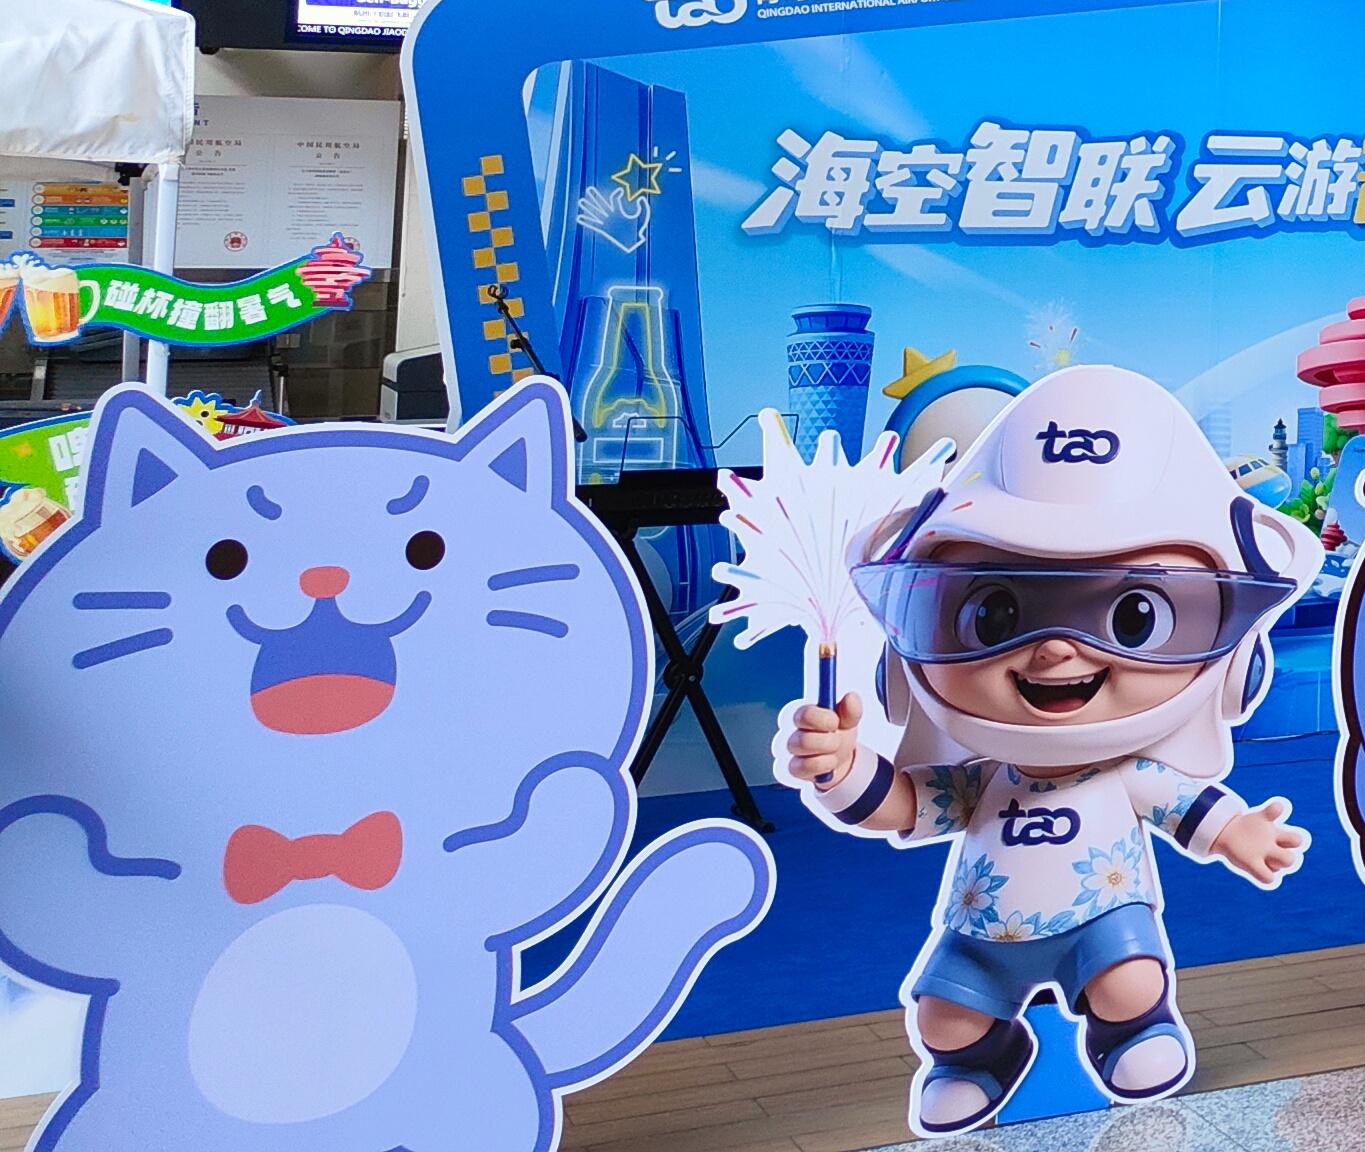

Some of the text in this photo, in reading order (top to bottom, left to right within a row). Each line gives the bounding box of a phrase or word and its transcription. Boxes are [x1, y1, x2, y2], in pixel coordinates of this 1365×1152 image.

[323, 25, 336, 34] TO
[338, 26, 381, 36] QINGDAO
[757, 4, 810, 19] QINGDAO
[741, 121, 1175, 236] 海空智联
[104, 279, 302, 331] 碰杯撞翻暑气
[1035, 421, 1121, 465] tao
[999, 799, 1081, 846] tao
